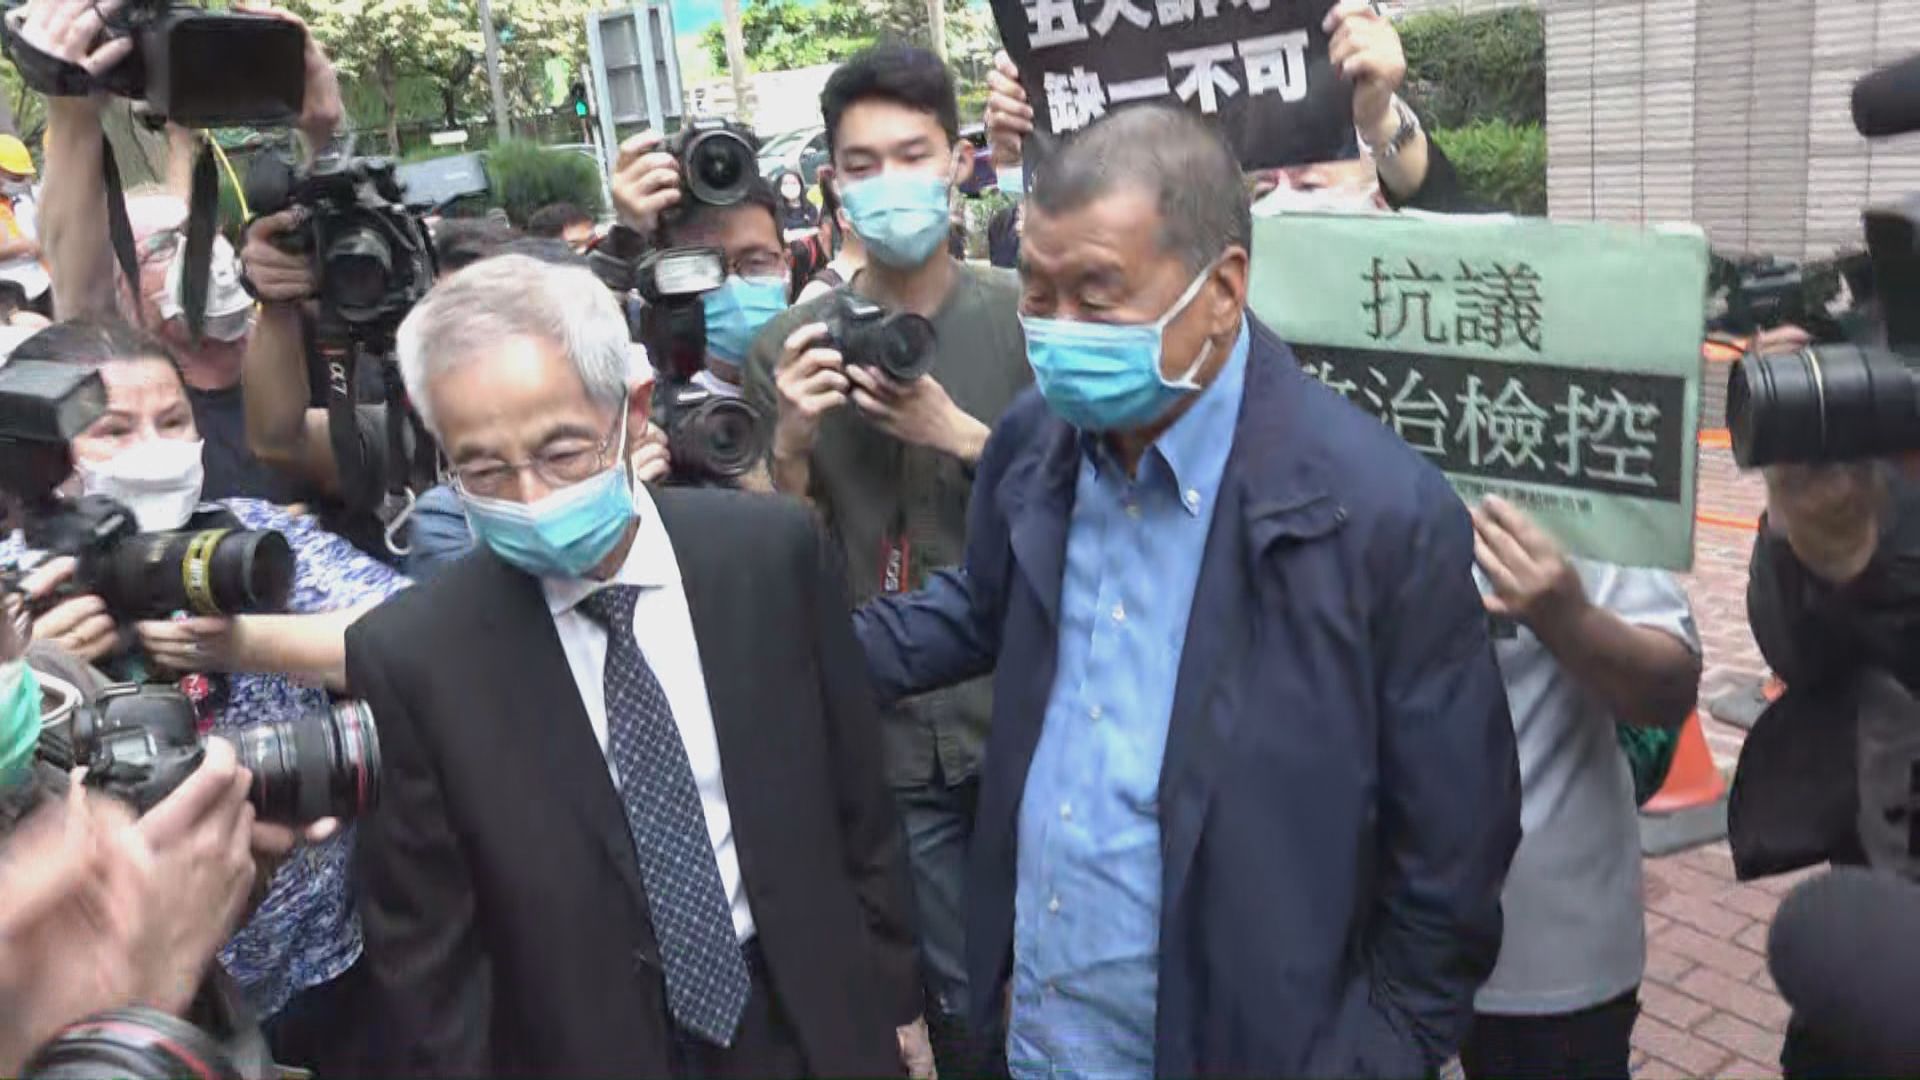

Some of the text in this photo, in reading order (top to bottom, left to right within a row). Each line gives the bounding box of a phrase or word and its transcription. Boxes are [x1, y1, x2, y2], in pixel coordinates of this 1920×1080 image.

[1043, 29, 1309, 134] 缺一不可
[1361, 256, 1543, 352] 抗議
[1301, 361, 1661, 488] 治檢控
